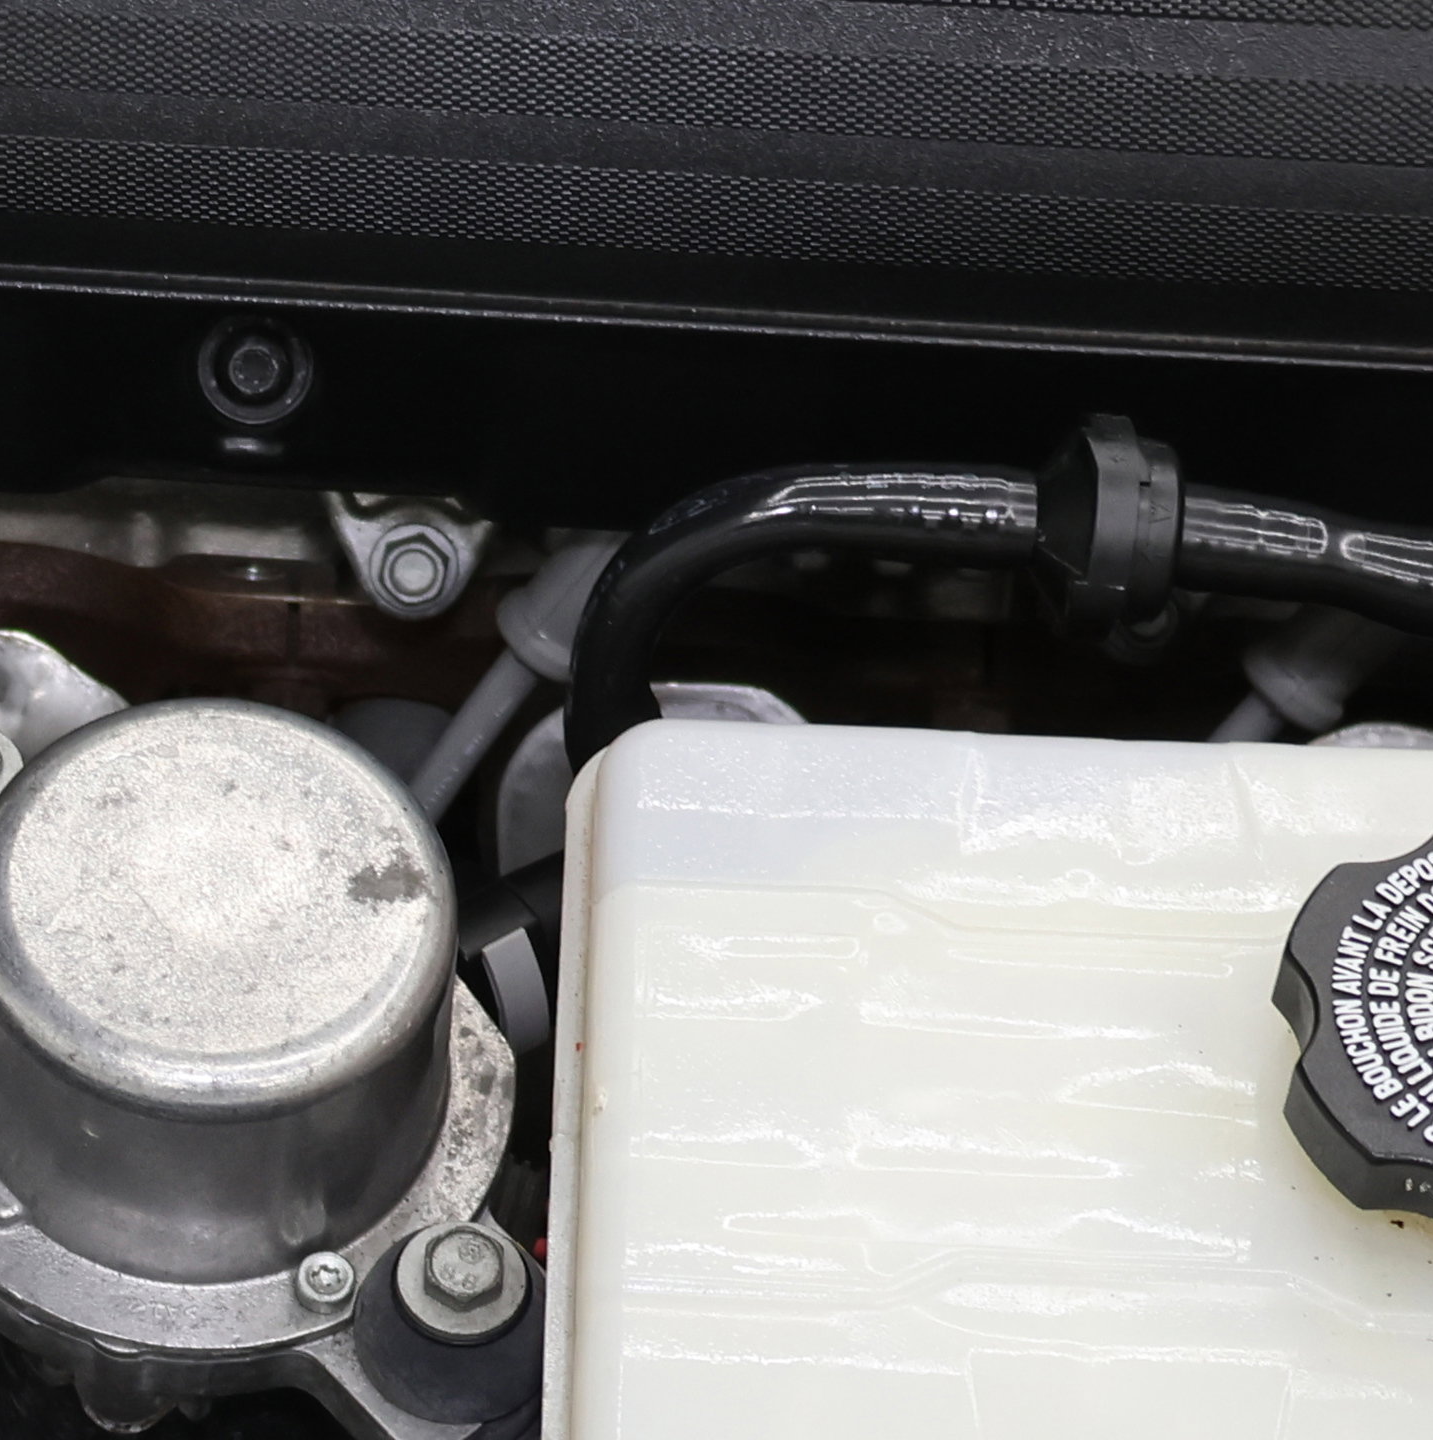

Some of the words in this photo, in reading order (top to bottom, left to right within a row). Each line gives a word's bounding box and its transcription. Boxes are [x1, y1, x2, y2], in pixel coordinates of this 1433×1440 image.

[1352, 899, 1392, 930] LA
[1373, 905, 1430, 966] FREIN
[1332, 926, 1373, 995] AVANT
[1368, 967, 1400, 996] DE
[1332, 999, 1403, 1100] BOUCHON
[1369, 1001, 1433, 1085] LIQUIDE
[1390, 1093, 1431, 1127] LE
